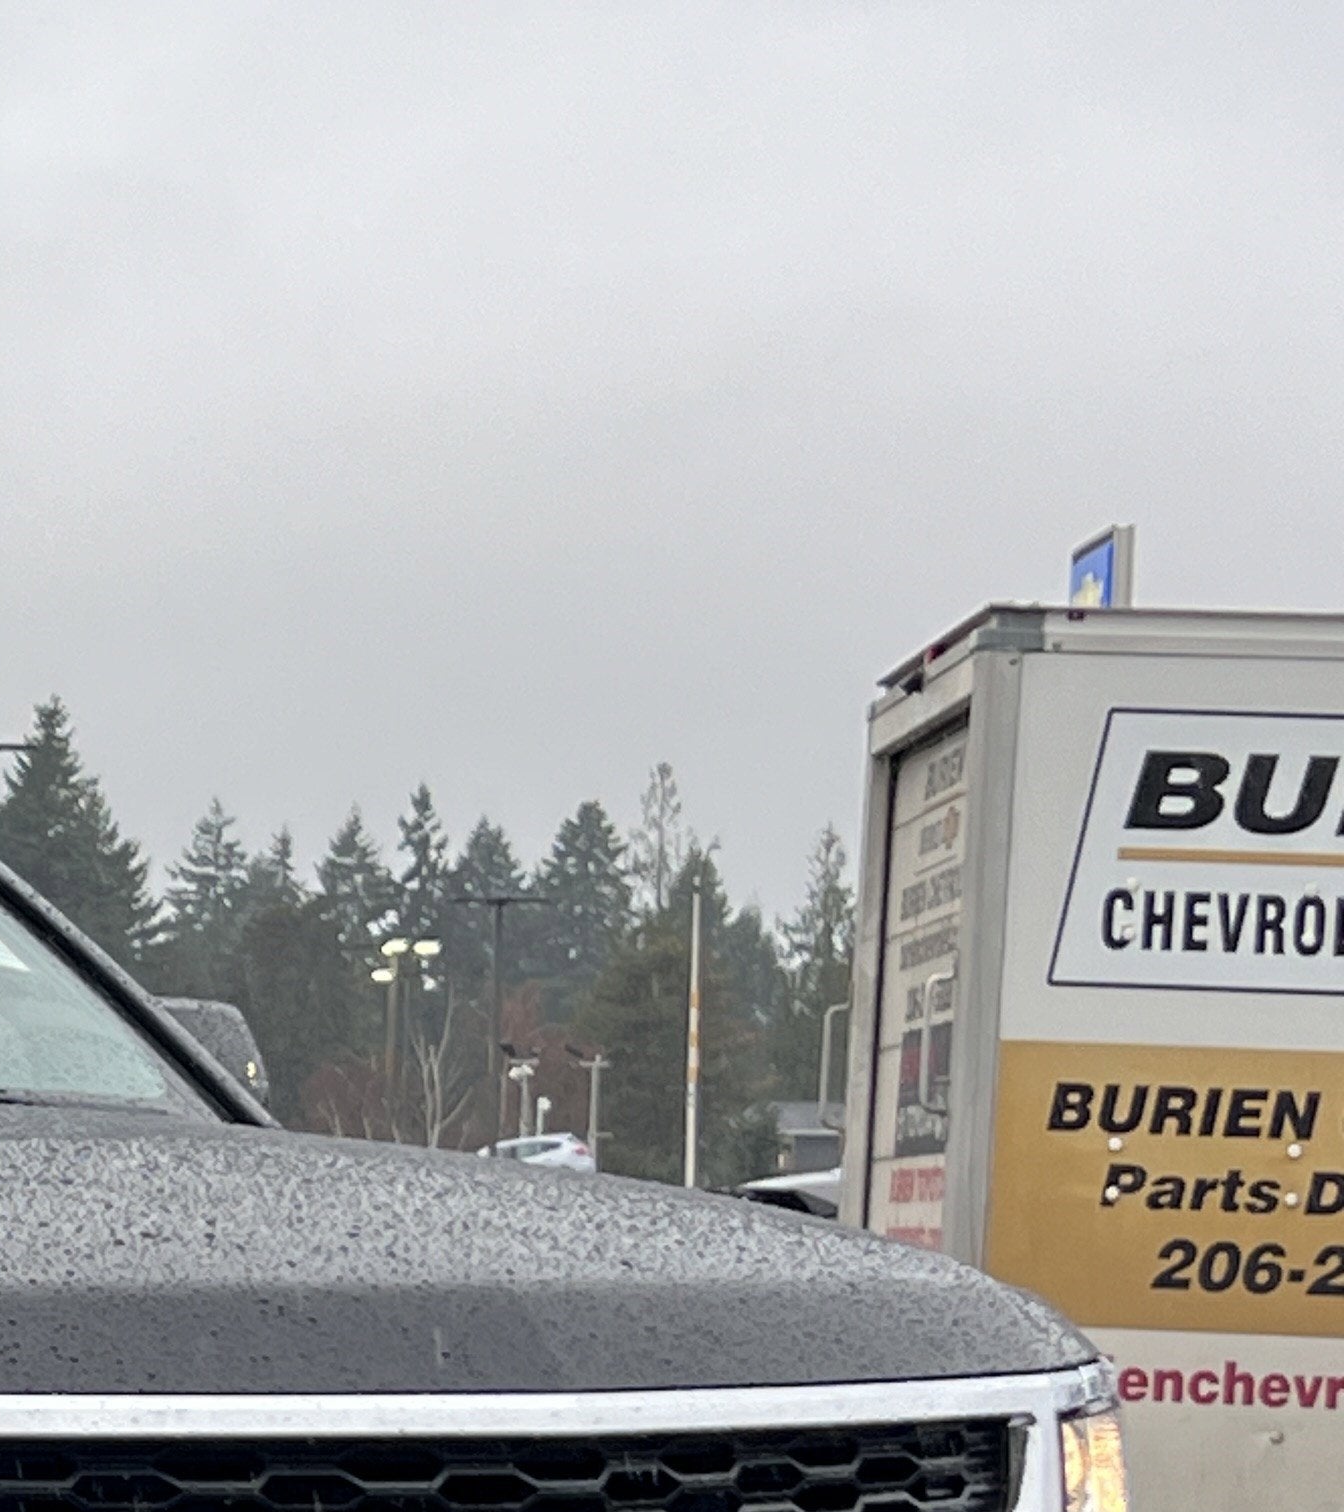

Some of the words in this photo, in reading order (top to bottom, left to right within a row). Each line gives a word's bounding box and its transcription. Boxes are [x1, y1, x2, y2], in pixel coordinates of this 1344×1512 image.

[1123, 750, 1344, 836] BU
[1047, 1082, 1321, 1140] BURIEN
[1100, 1163, 1282, 1214] Parts
